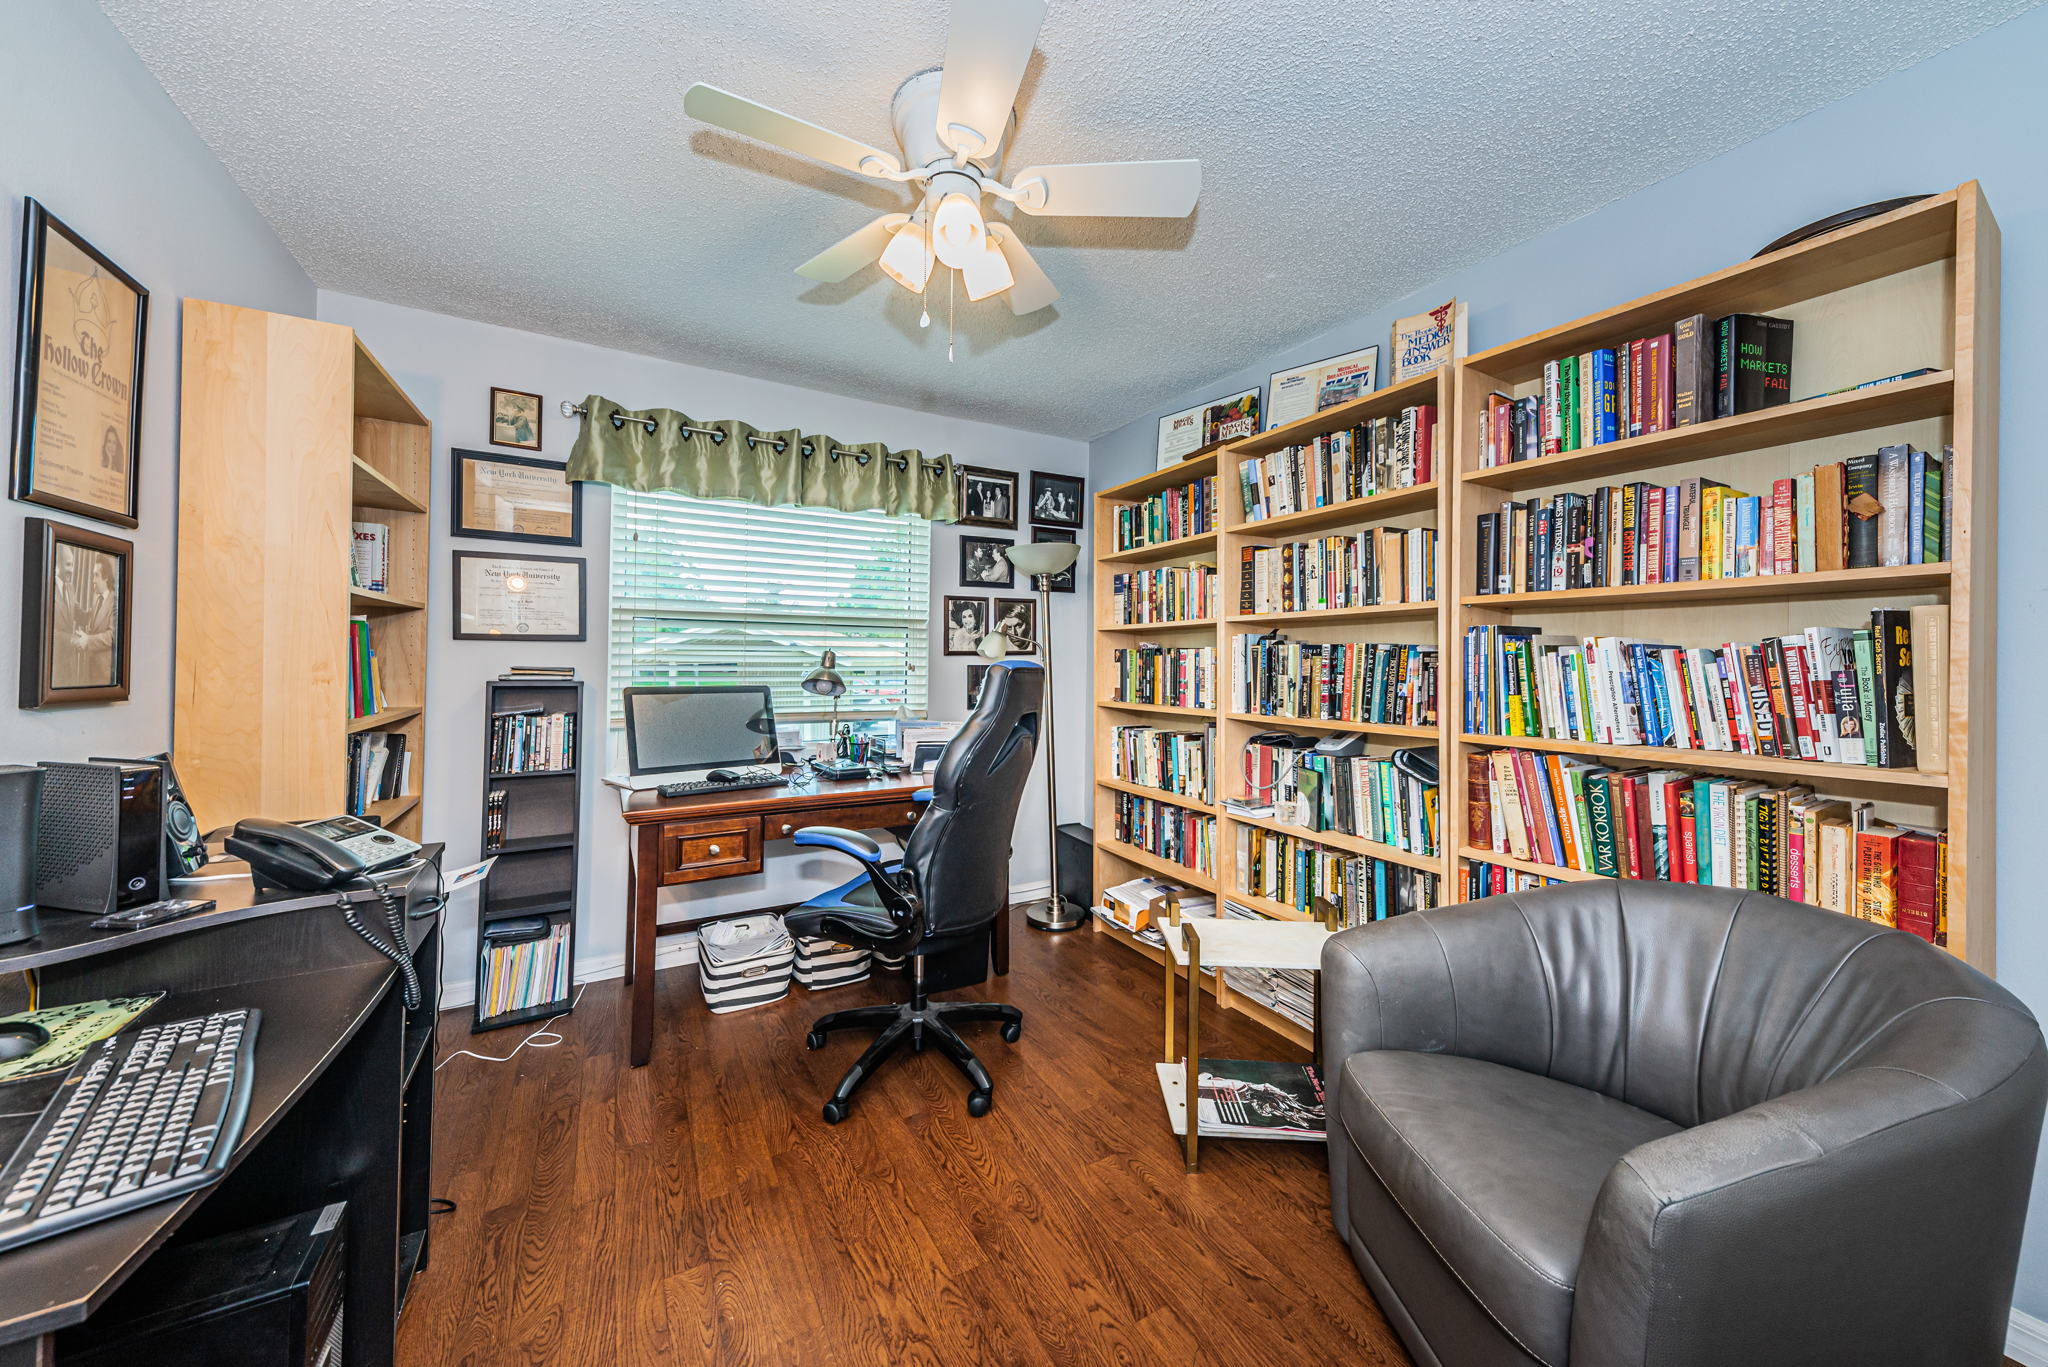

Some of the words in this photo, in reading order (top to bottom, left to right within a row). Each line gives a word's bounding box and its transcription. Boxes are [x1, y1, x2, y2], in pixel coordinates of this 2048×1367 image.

[1400, 333, 1412, 341] The
[1408, 324, 1453, 348] MEDICAL
[1678, 331, 1694, 341] GOLD
[1721, 320, 1729, 337] HOW
[80, 331, 103, 364] The
[1403, 335, 1450, 359] ANSWER
[1720, 338, 1729, 372] MARKETS
[1741, 343, 1763, 356] HOW
[43, 334, 89, 379] Hollow
[92, 362, 127, 401] Crown
[1402, 352, 1431, 368] BOOK
[1741, 358, 1788, 375] MARKETS
[1720, 374, 1728, 391] FAIL
[1764, 377, 1790, 390] FAIL
[1221, 425, 1249, 439] MEALS
[1222, 419, 1249, 431] MAGIC
[1848, 457, 1865, 465] Mixed
[1848, 463, 1872, 471] Company
[480, 466, 496, 475] New
[499, 469, 517, 478] York
[518, 470, 557, 483] University
[1555, 497, 1563, 517] JAMES
[1649, 502, 1660, 530] LOOKING
[1775, 506, 1791, 526] JAMES
[1682, 504, 1690, 531] TRIANGLE
[1554, 518, 1563, 554] PATTERSON
[1624, 531, 1635, 554] CROSS
[1649, 532, 1660, 546] FOR
[1775, 526, 1791, 560] PATTERSON
[1624, 555, 1634, 571] FIRE
[1648, 548, 1659, 575] TROUBLE
[485, 569, 501, 577] New
[522, 570, 560, 581] University
[1398, 649, 1407, 681] TRIGGERED
[1785, 649, 1800, 685] WORKING
[1365, 672, 1373, 699] GRANT
[1608, 670, 1617, 701] Prescription
[1861, 677, 1872, 693] Book
[1792, 696, 1806, 718] ROOM
[1839, 683, 1857, 711] Julia
[1612, 702, 1621, 734] Alternatives
[1751, 689, 1772, 731] USED
[1864, 700, 1873, 722] Money
[1712, 791, 1725, 805] THE
[1589, 784, 1609, 842] KOKBOK
[1713, 806, 1726, 828] VIRGIN
[1684, 832, 1695, 864] spanish
[1714, 829, 1727, 847] DIET
[1863, 846, 1872, 866] PLAYED
[1874, 851, 1882, 860] THE
[1789, 848, 1801, 889] desserts
[1863, 867, 1872, 880] WITH
[1874, 861, 1882, 874] GIRL
[1863, 881, 1872, 894] FIRE
[1874, 876, 1882, 888] WHO
[1873, 900, 1882, 916] STIEG
